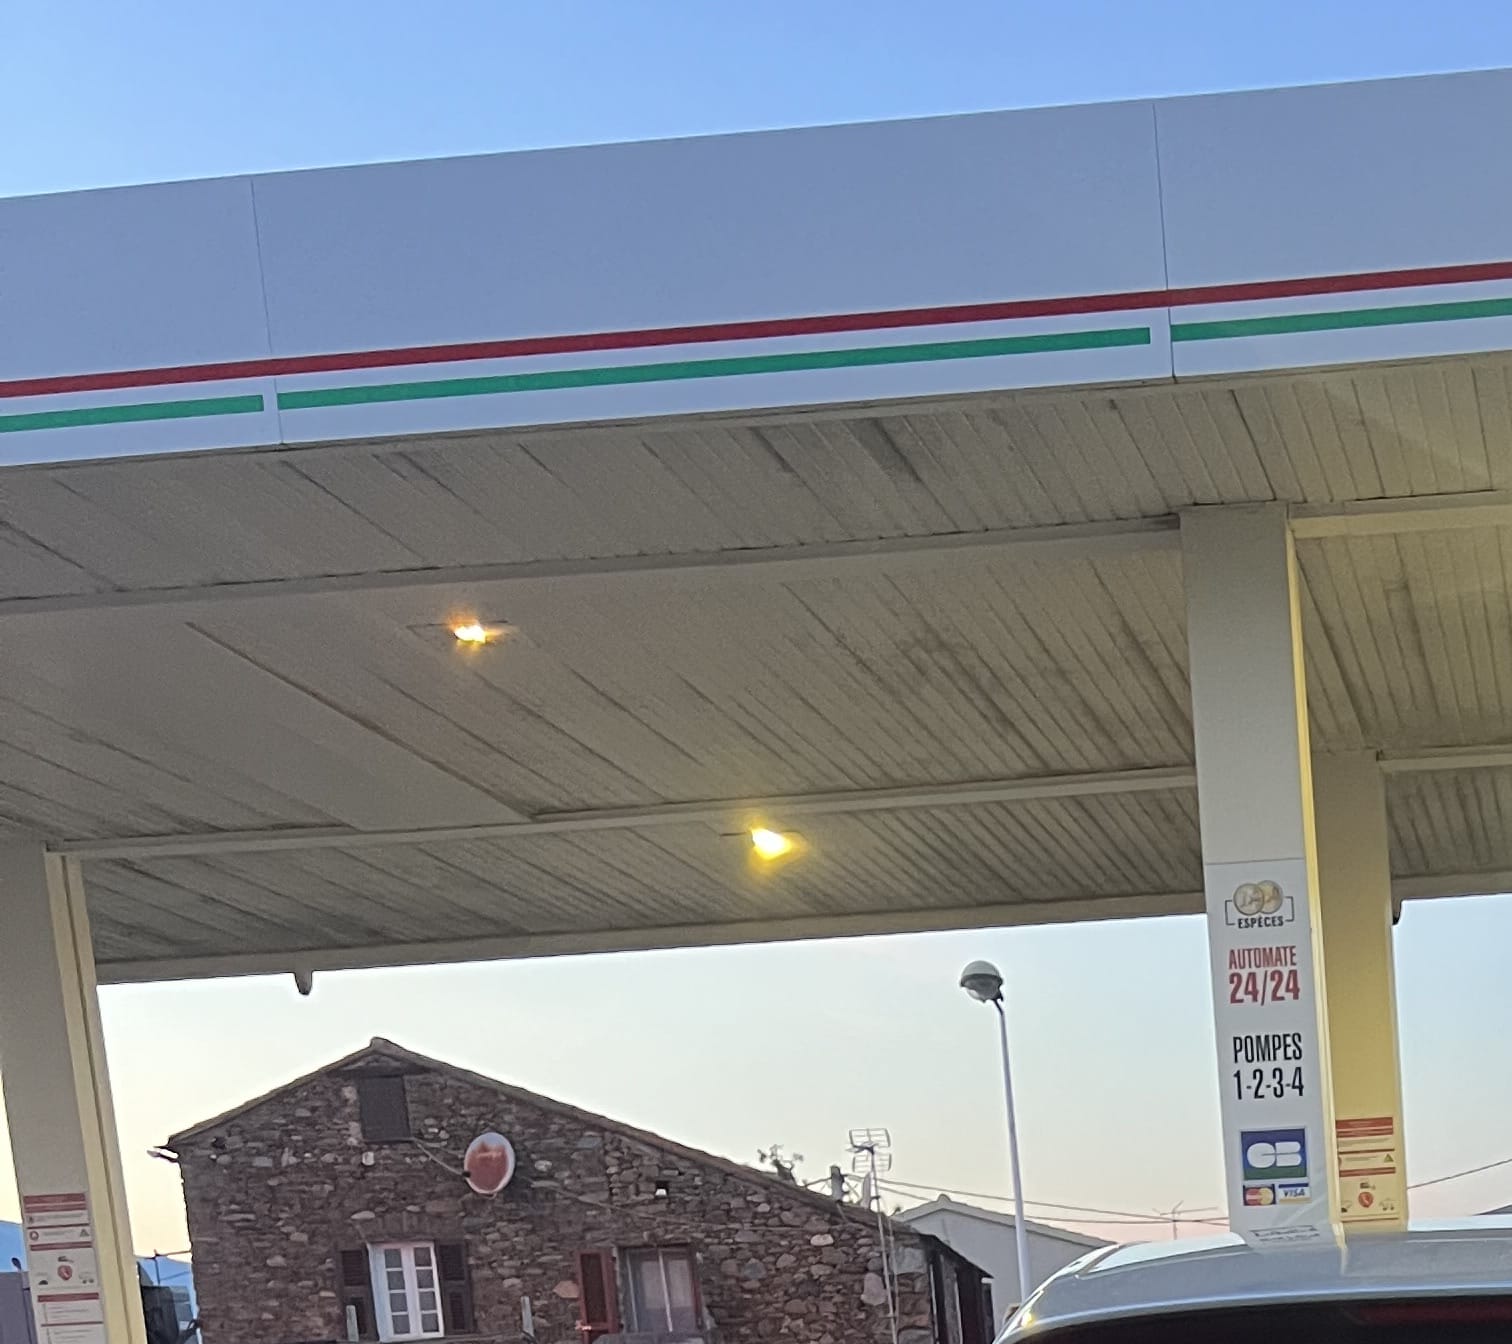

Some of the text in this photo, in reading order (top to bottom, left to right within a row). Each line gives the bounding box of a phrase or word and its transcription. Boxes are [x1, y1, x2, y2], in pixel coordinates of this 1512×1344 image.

[1228, 946, 1297, 969] AUTOMATE
[1229, 969, 1300, 1006] 24/24
[1233, 1032, 1303, 1064] POMPES
[1233, 1067, 1304, 1100] 1-2-3-4
